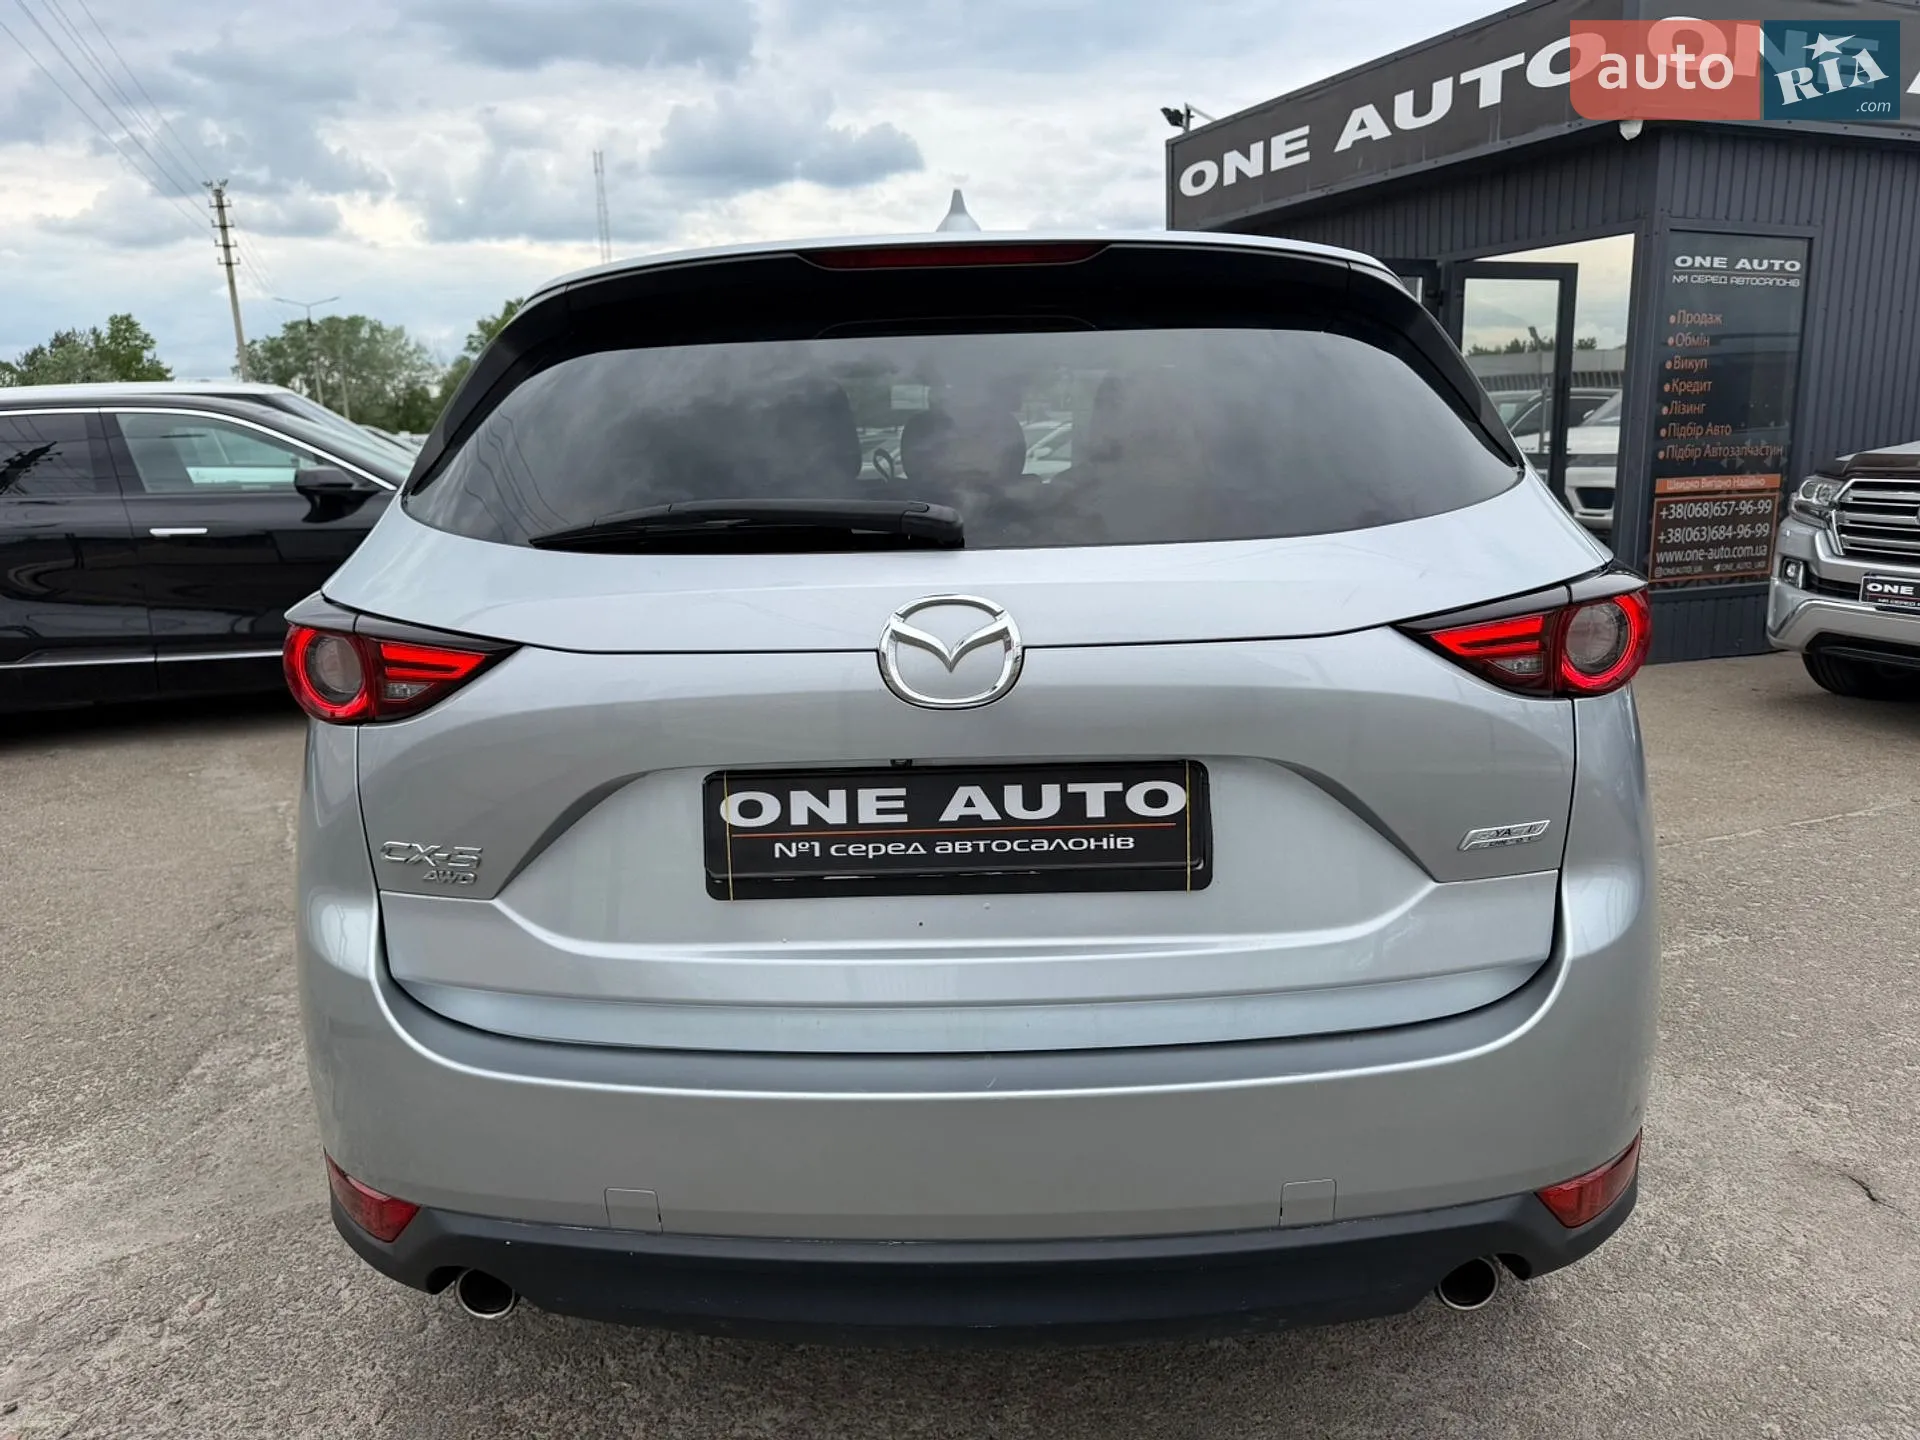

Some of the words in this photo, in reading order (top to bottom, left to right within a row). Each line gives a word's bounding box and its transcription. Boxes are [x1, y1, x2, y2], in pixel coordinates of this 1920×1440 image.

[1179, 125, 1311, 197] ONE
[1335, 33, 1606, 152] AUTO
[1675, 255, 1728, 268] ONE
[1735, 258, 1801, 272] AUTO
[1677, 310, 1723, 327] Продаж
[1675, 332, 1710, 347] Обмін
[1673, 355, 1708, 372] Викуп
[1671, 379, 1712, 395] Кредит
[1669, 400, 1706, 415] Лізинг
[1667, 422, 1703, 439] Підбір
[1705, 422, 1732, 436] Авто
[1665, 444, 1701, 462] Підбір
[1703, 444, 1783, 458] Автозапчастин
[1660, 500, 1772, 520] +38(068)657-96-99
[1658, 522, 1770, 544] +38(063)684-96-99
[1656, 545, 1768, 563] www.one-auto.com.ua
[1866, 583, 1914, 595] ONE
[720, 787, 908, 828] ONE
[939, 780, 1187, 823] AUTO
[380, 841, 482, 868] CX-5
[830, 838, 927, 859] серед
[935, 833, 1135, 855] автосалонів
[422, 869, 478, 885] AWD
